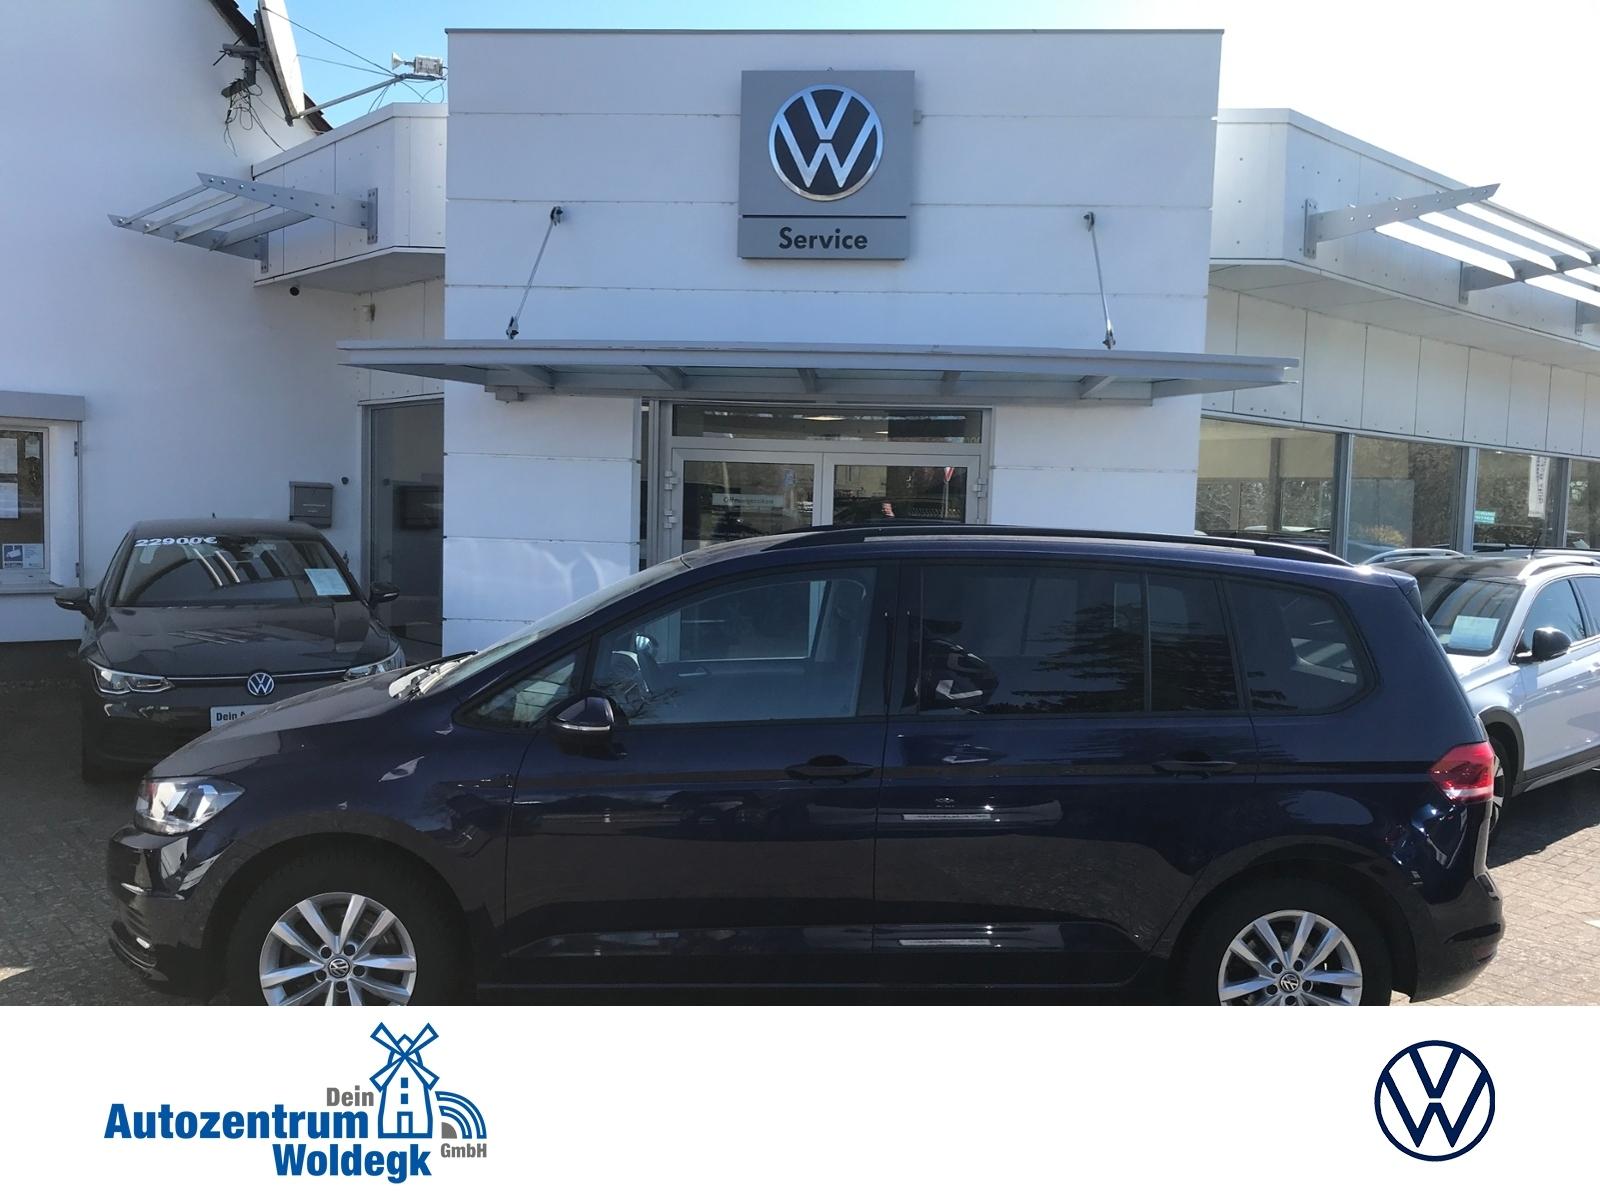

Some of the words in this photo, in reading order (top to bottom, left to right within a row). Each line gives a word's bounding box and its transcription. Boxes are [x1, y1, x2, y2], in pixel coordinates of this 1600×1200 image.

[770, 85, 883, 201] VW
[779, 227, 867, 249] Service
[134, 536, 218, 548] 22900€
[247, 672, 274, 695] VW
[216, 712, 238, 722] Dein
